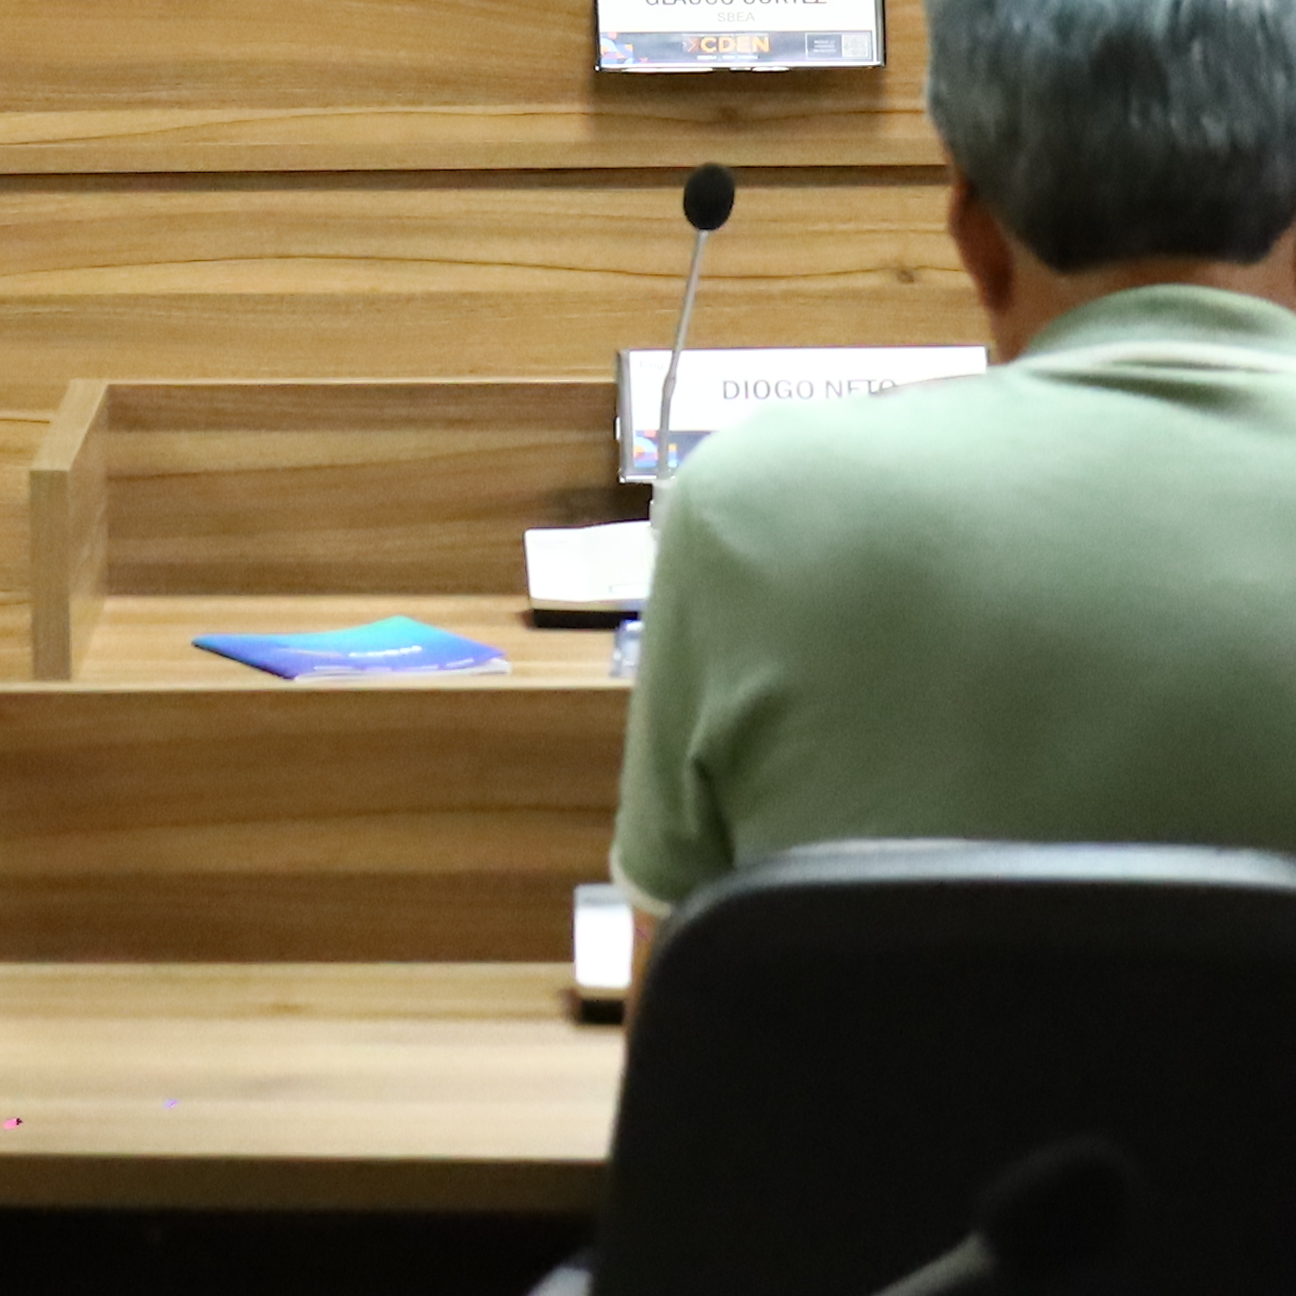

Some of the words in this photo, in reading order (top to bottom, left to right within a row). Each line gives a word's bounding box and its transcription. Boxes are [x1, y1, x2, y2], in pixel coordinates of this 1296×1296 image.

[716, 11, 756, 23] SBEA
[699, 35, 771, 54] CDEN
[722, 379, 815, 401] DIOGO
